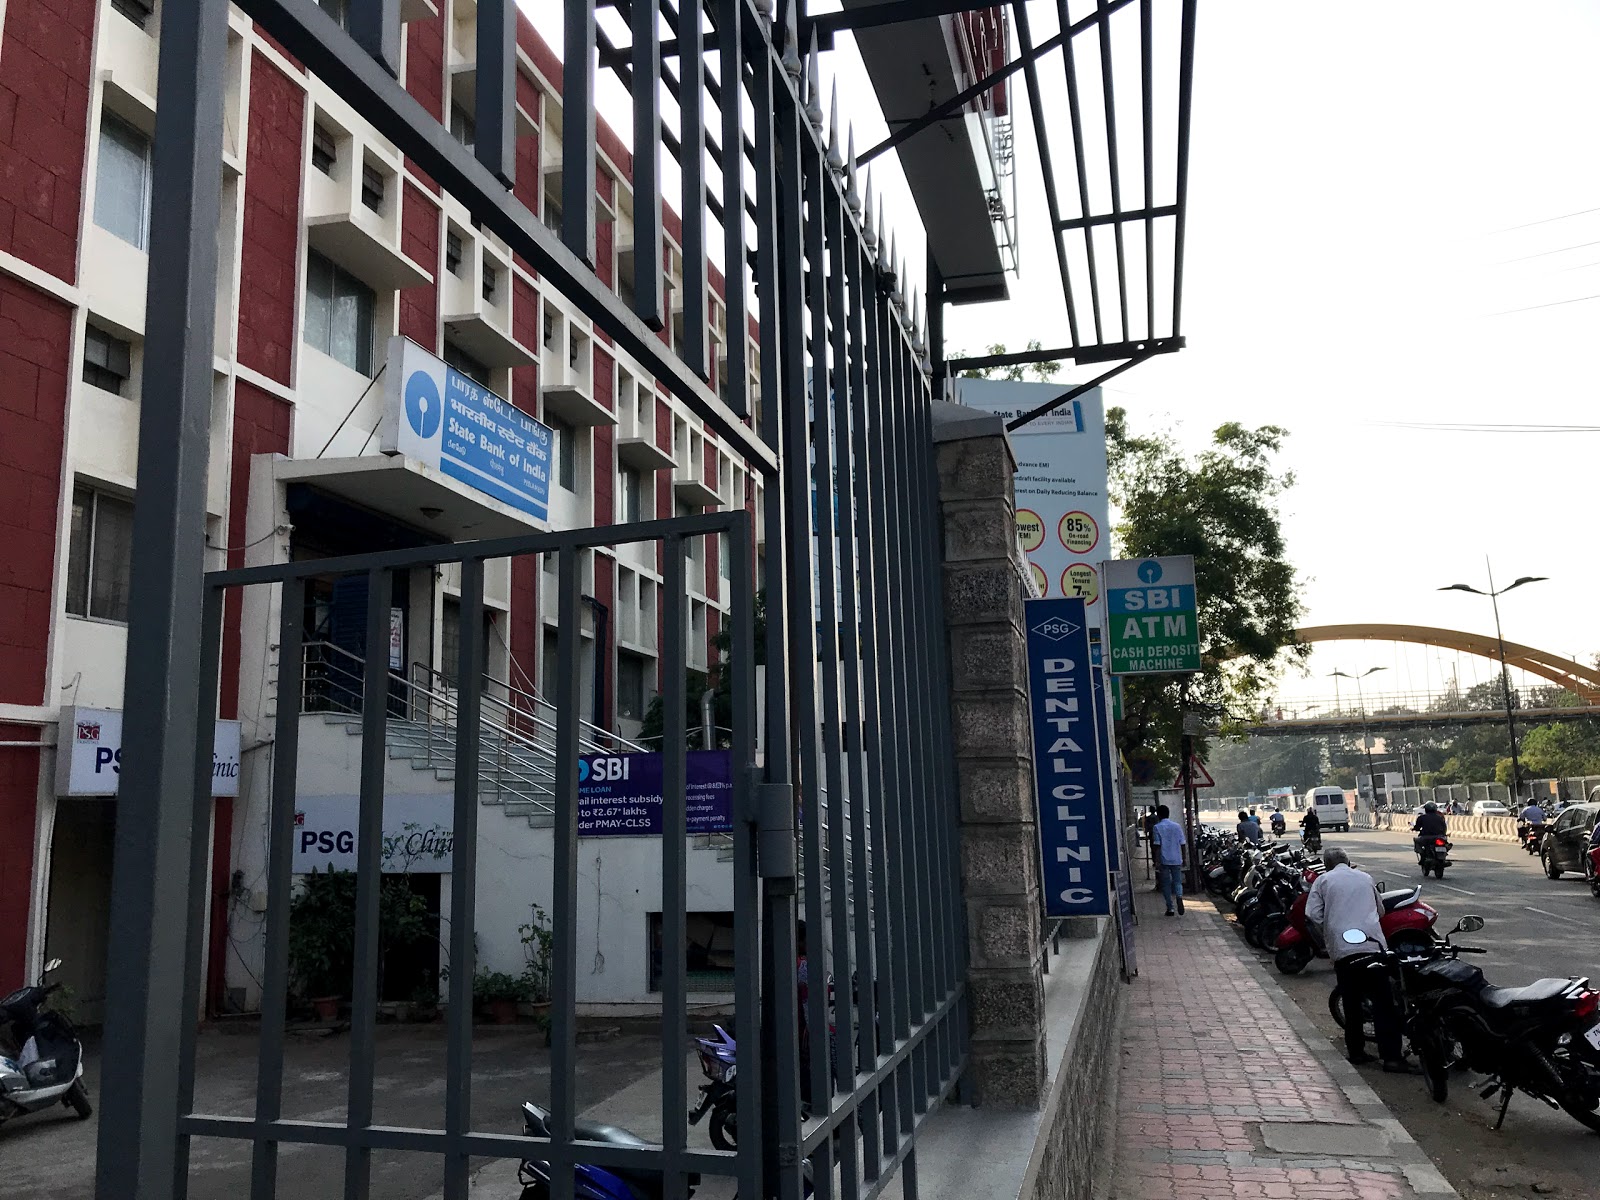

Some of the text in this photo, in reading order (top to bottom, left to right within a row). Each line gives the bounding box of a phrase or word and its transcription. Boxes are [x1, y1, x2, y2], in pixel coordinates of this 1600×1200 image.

[1051, 408, 1071, 417] India
[450, 398, 497, 433] भारतीय
[497, 425, 525, 448] स्टेट
[449, 417, 546, 482] State Bank of India
[1067, 518, 1091, 532] 85%
[1125, 588, 1180, 610] SBI
[1044, 623, 1069, 634] PSG
[1122, 615, 1187, 639] ATM
[1113, 646, 1144, 659] CASH
[1148, 644, 1199, 657] DEPOSIT
[1129, 658, 1184, 670] MACHINE
[591, 757, 630, 781] SBI
[1044, 658, 1095, 904] DENTAL CLINIC
[591, 795, 628, 804] interest
[629, 794, 663, 806] subsidy
[623, 807, 647, 816] lakhs
[595, 818, 651, 829] PMAY-CLSS
[301, 831, 354, 854] PSG
